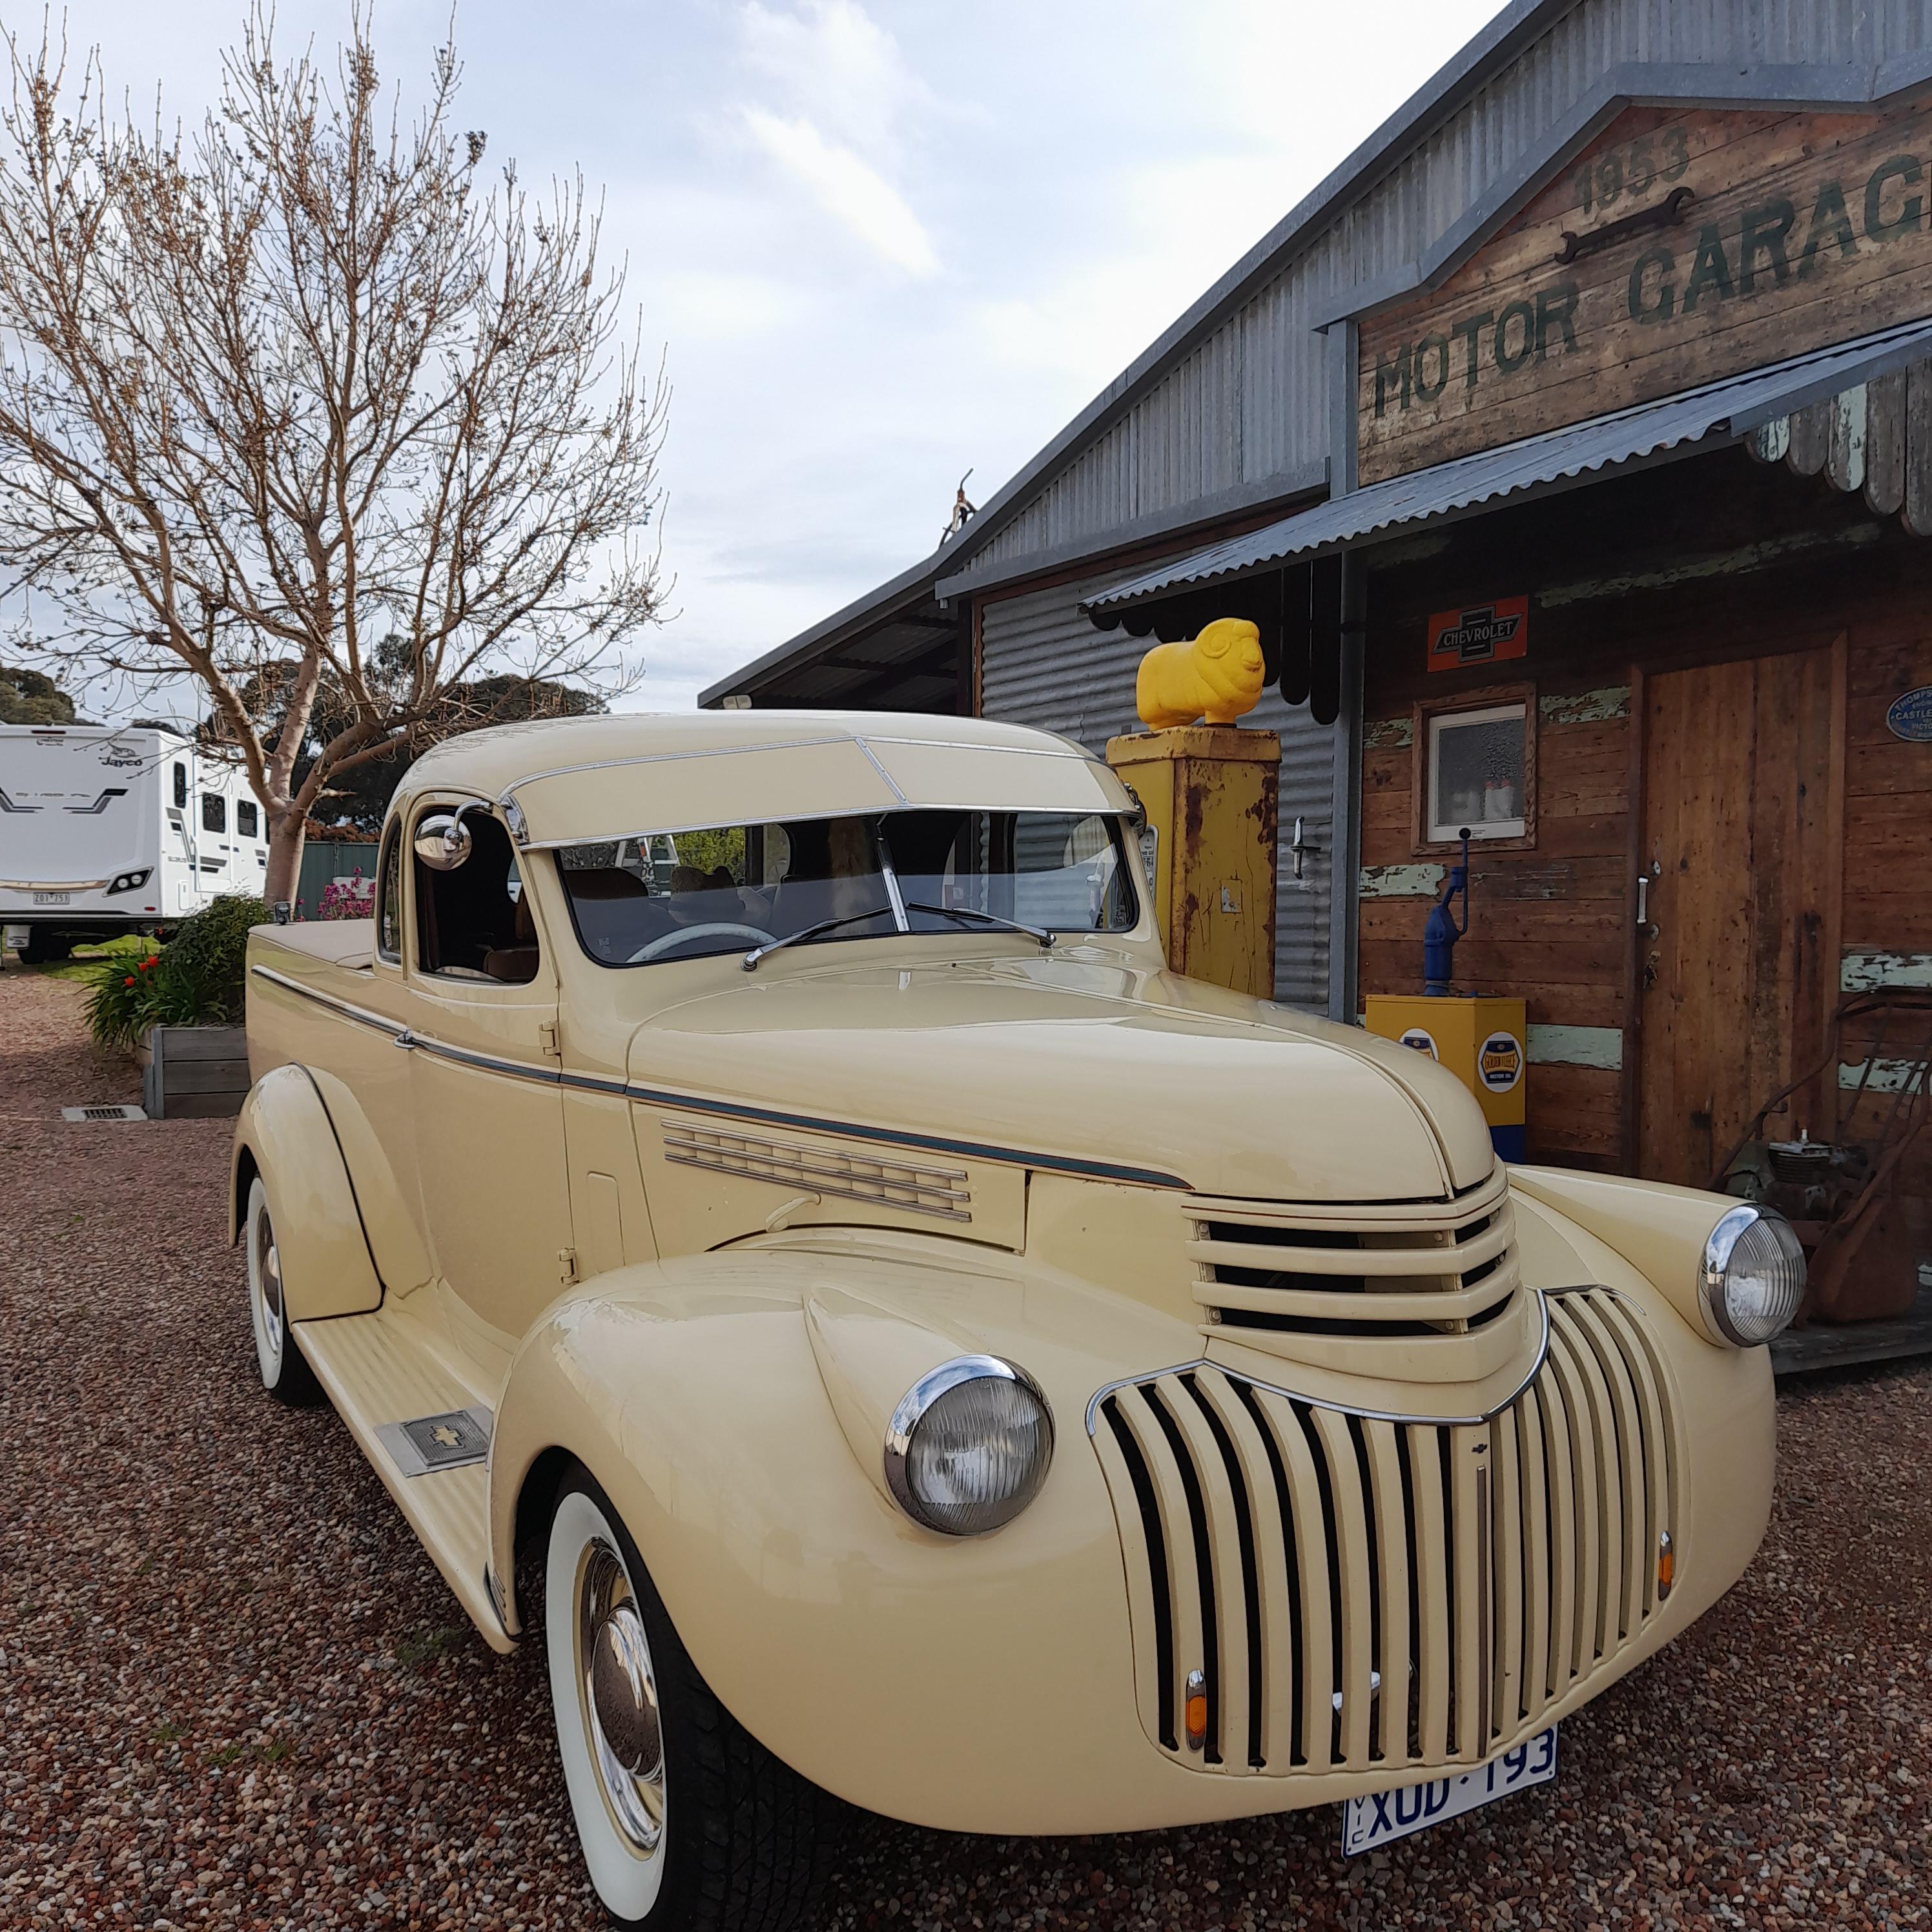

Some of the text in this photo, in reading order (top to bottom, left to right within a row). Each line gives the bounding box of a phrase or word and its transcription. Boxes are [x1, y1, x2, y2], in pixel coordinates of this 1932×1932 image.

[1574, 127, 1689, 215] 1953
[1375, 154, 1932, 418] MOTOR GARAG
[1443, 621, 1513, 646] CHEVROLET
[101, 757, 142, 767] Jayco
